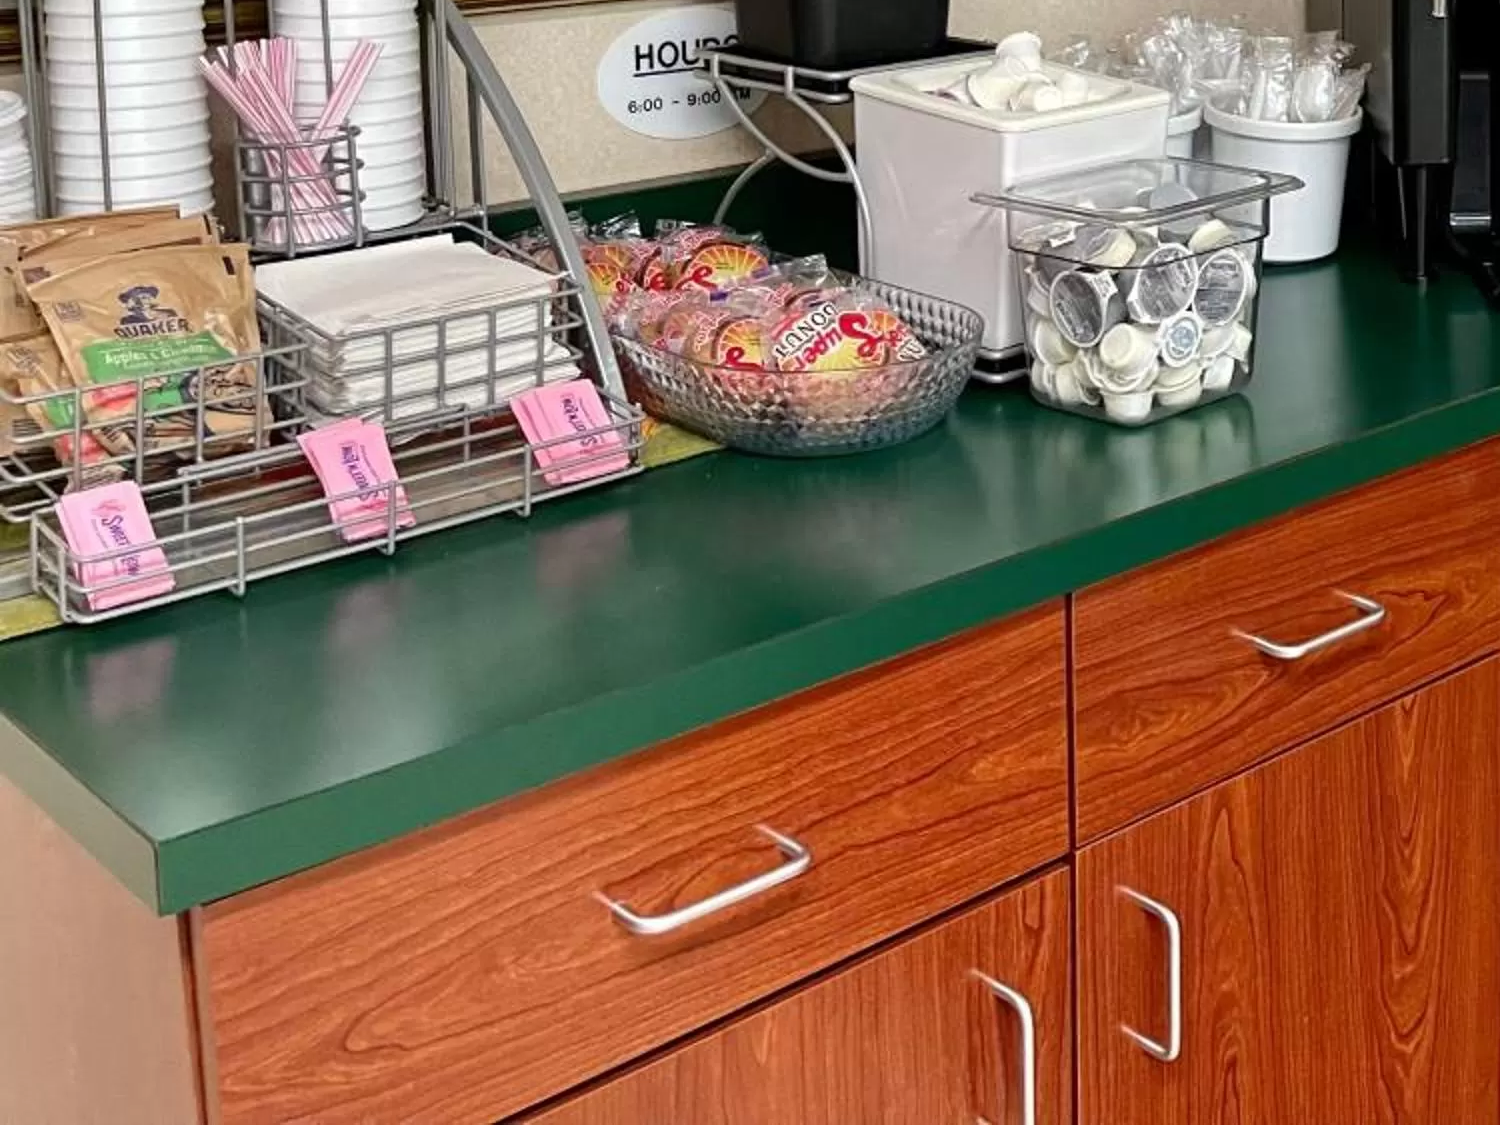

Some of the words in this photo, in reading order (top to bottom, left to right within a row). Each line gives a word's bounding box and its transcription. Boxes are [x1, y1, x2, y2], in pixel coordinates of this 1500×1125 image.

[628, 98, 663, 114] 6:00
[687, 89, 721, 106] 9:00
[113, 318, 189, 338] QUAKER
[796, 312, 882, 369] Super
